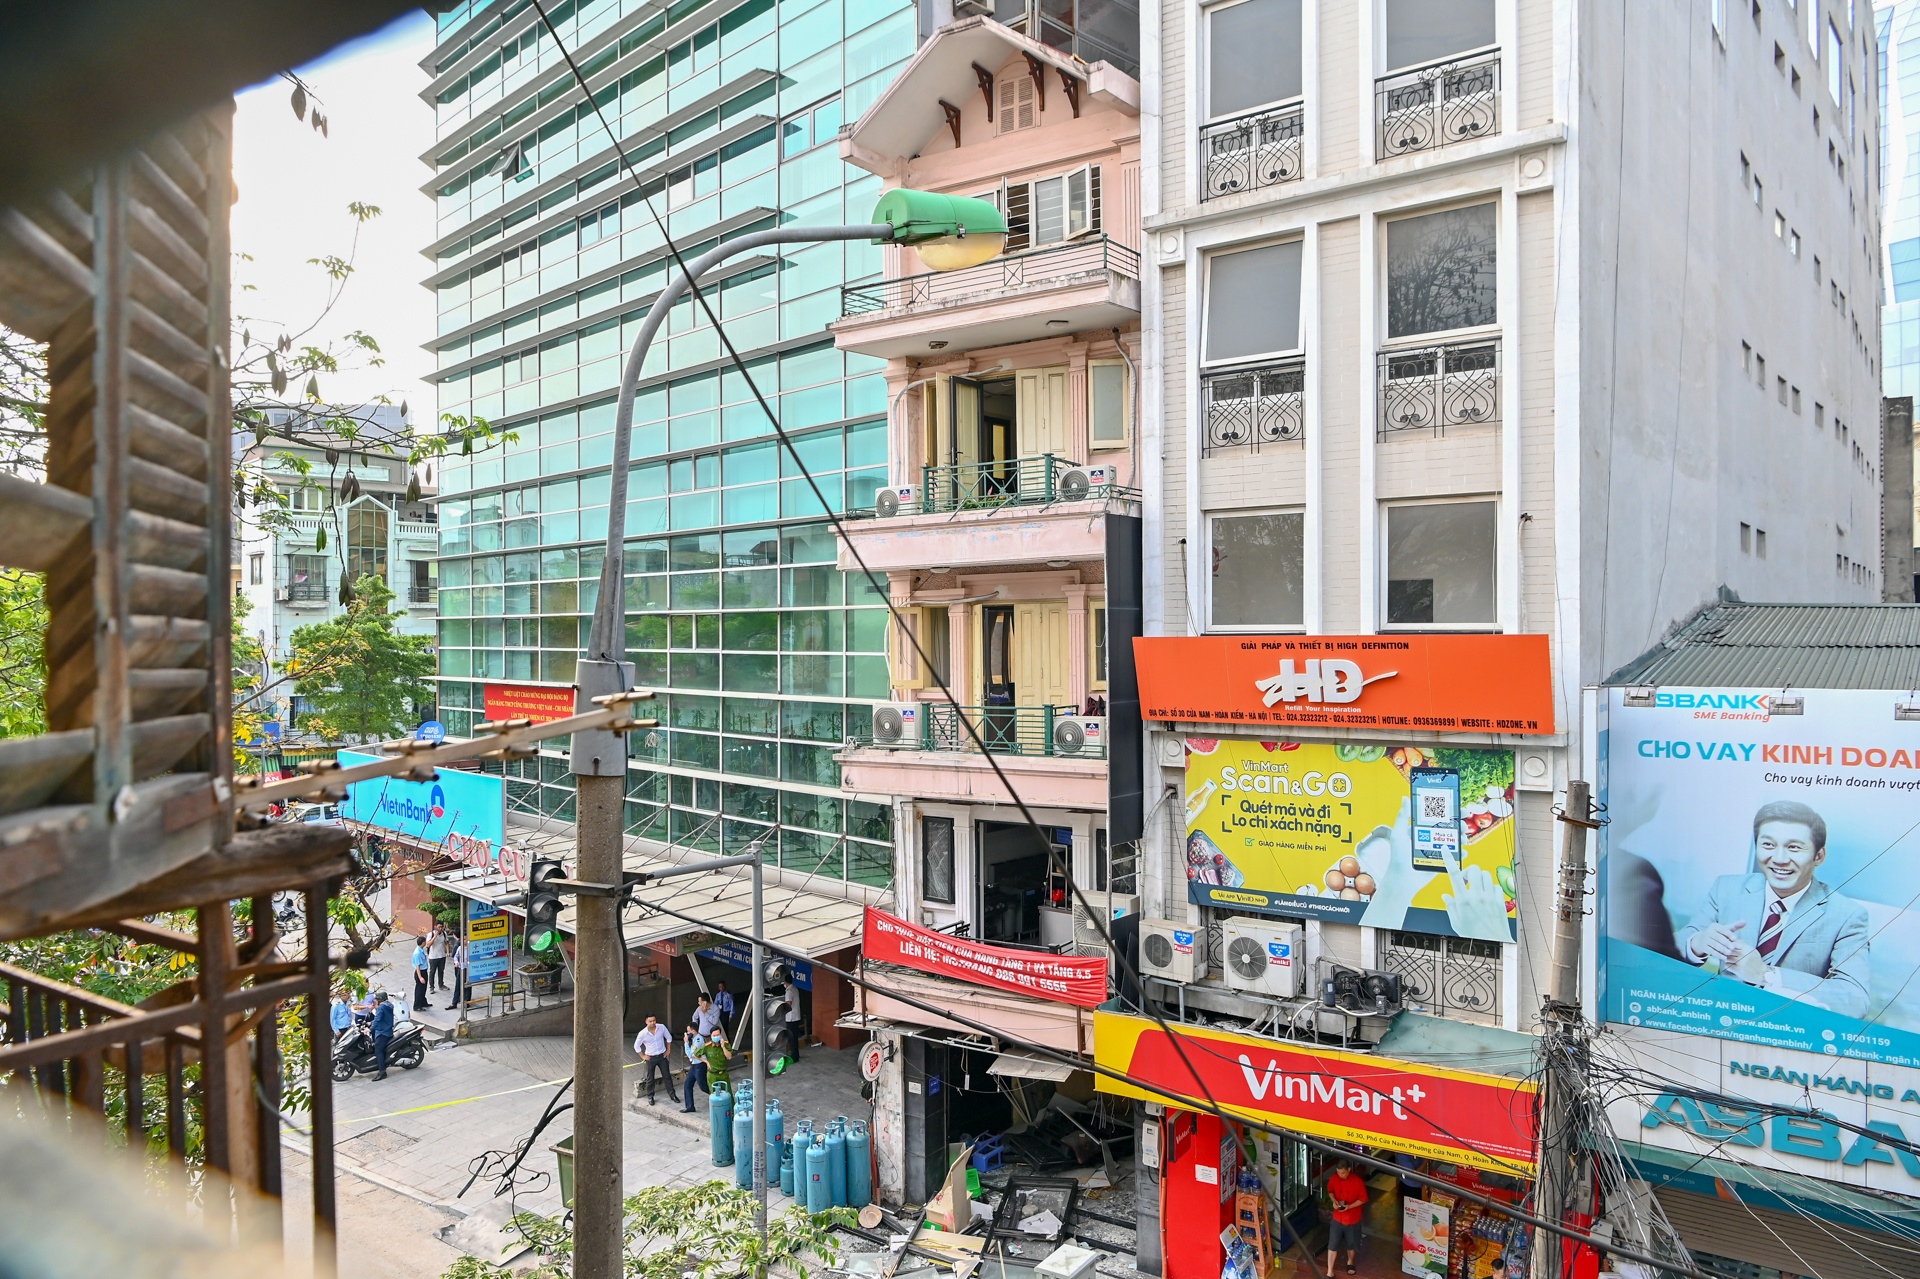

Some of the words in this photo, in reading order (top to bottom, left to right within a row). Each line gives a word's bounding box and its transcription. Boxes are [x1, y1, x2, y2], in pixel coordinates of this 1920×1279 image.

[1241, 641, 1257, 650] GIẢI
[1261, 641, 1282, 650] PHÁP
[1285, 640, 1295, 650] VÀ
[1299, 639, 1322, 650] THIẾT
[1325, 642, 1334, 651] BỊ
[1337, 642, 1357, 650] HIGH
[1361, 642, 1409, 650] DEFINITION
[1170, 708, 1178, 718] SỐ
[1178, 710, 1185, 718] 30
[1187, 709, 1197, 718] CỬA
[1215, 710, 1229, 719] HOÀN
[1230, 709, 1244, 720] KIẾM
[1249, 710, 1257, 720] HÀ
[1258, 710, 1268, 721] NỘI
[1272, 713, 1285, 721] TEL:
[1286, 713, 1328, 722] 024.32323212
[1333, 716, 1377, 724] 024.32323216
[1382, 717, 1411, 725] HOTLINE:
[1413, 718, 1456, 727] 0936369899
[1461, 719, 1494, 728] WEBSITE:
[1694, 711, 1717, 720] SME
[1720, 712, 1770, 723] Banking
[1637, 739, 1691, 760] CHO
[1696, 742, 1757, 762] VAY
[1762, 744, 1832, 766] KINH
[1241, 760, 1289, 773] VinMart
[1764, 772, 1787, 784] Cho
[1790, 775, 1812, 787] vay
[1816, 774, 1842, 787] kinh
[1845, 776, 1885, 789] doanh
[381, 791, 433, 824] VietinBank
[1240, 799, 1273, 815] Quét
[1275, 803, 1297, 817] mã
[1299, 803, 1315, 818] và
[1317, 804, 1331, 819] đi
[1232, 813, 1247, 827] Lo
[1249, 815, 1268, 829] chi
[1270, 816, 1303, 832] xách
[1305, 820, 1342, 838] nặng
[1258, 840, 1275, 848] GIAO
[1276, 842, 1295, 850] HÀNG
[1297, 841, 1313, 851] MIỄN
[1315, 844, 1327, 852] PHÍ
[877, 919, 894, 933] CHO
[1033, 960, 1046, 975] VÀ
[1047, 962, 1073, 978] TẦNG
[1076, 968, 1092, 979] 4.5
[1174, 944, 1192, 953] Funiki
[900, 940, 922, 957] LIÊN
[924, 946, 940, 963] HỆ:
[1039, 979, 1068, 993] 5555
[1270, 957, 1289, 966] Funiki
[1630, 989, 1657, 1000] NGÂN
[1658, 991, 1685, 1003] HÀNG
[1687, 997, 1714, 1007] TMCP
[1715, 1001, 1730, 1010] AN
[1731, 1002, 1755, 1013] BÌNH
[1646, 1005, 1712, 1021] abbank_anbinh
[1733, 1017, 1805, 1034] www.abbank.vn
[1841, 1032, 1891, 1047] 18001159
[1886, 1054, 1911, 1066] ngân
[1730, 1060, 1809, 1086] NGÂN
[1812, 1073, 1894, 1100] HÀNG
[1346, 1130, 1355, 1138] Số
[1392, 1139, 1407, 1149] Nam,
[1446, 1151, 1463, 1160] Nam,
[1464, 1154, 1471, 1162] Q.
[1473, 1155, 1489, 1164] Hoàn
